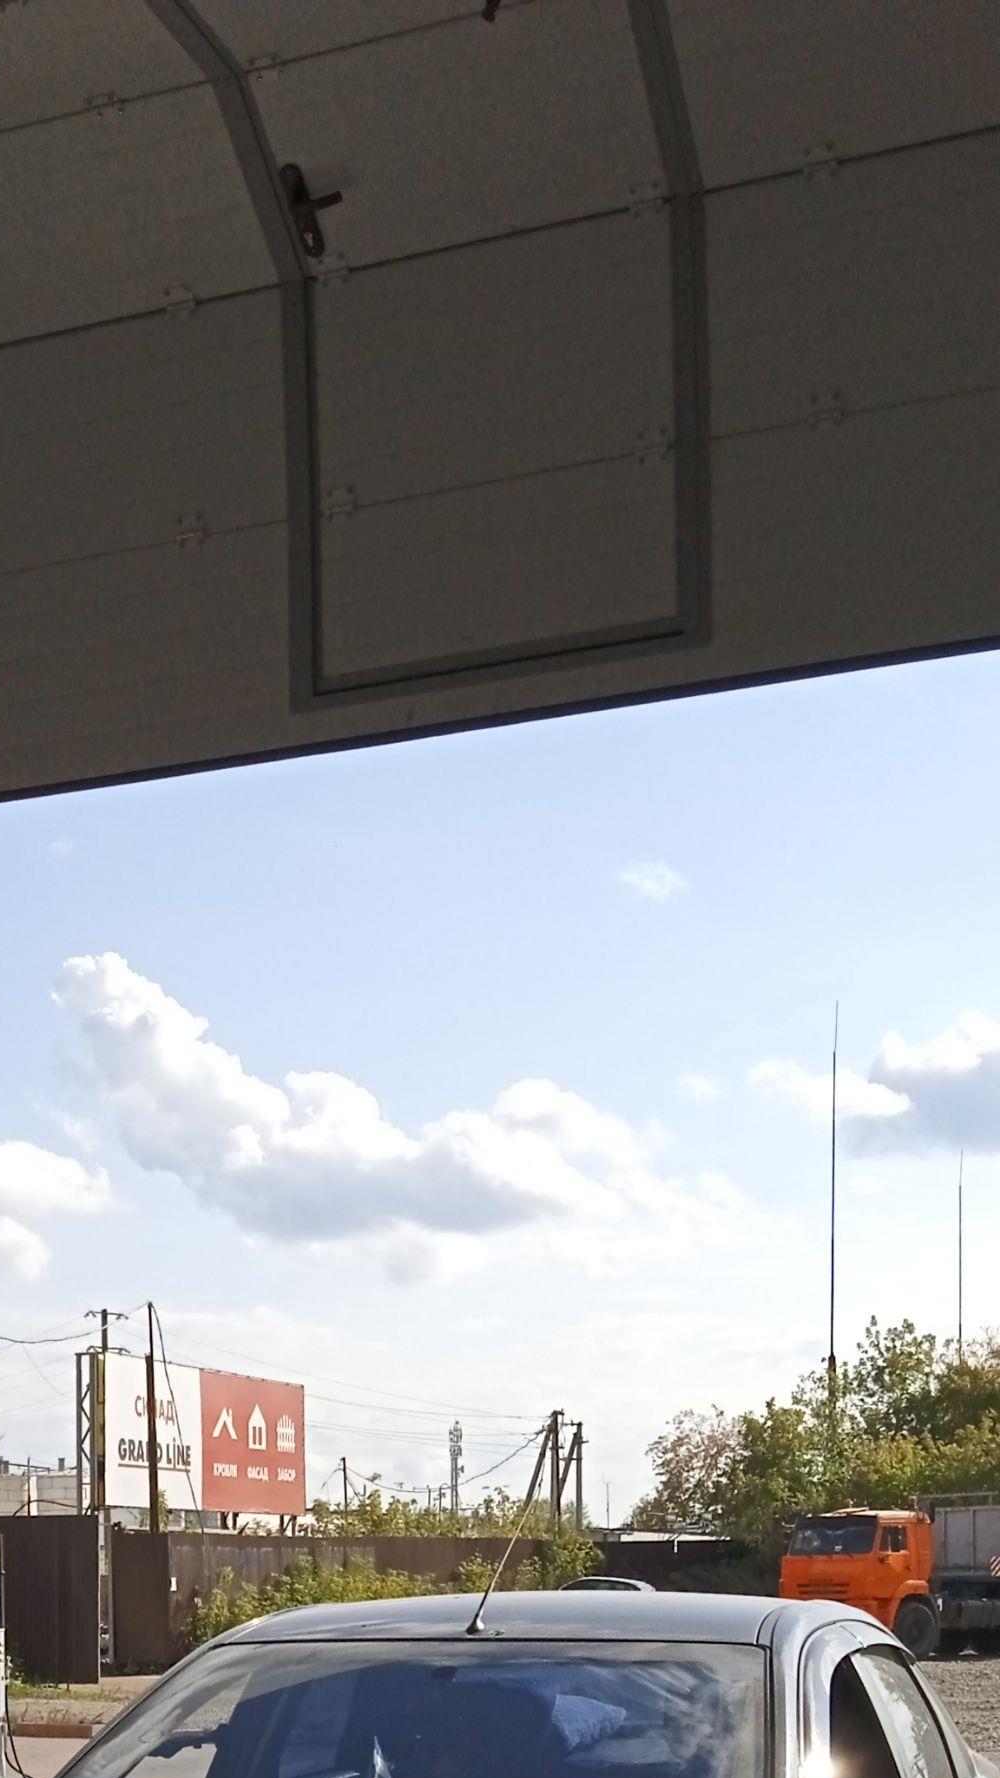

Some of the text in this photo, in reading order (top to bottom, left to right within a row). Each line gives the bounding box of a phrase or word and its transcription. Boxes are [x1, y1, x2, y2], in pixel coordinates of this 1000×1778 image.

[134, 1395, 175, 1425] САД
[118, 1437, 163, 1464] GRAD
[247, 1465, 269, 1483] ФАСАД
[277, 1468, 296, 1483] ЗАБОР
